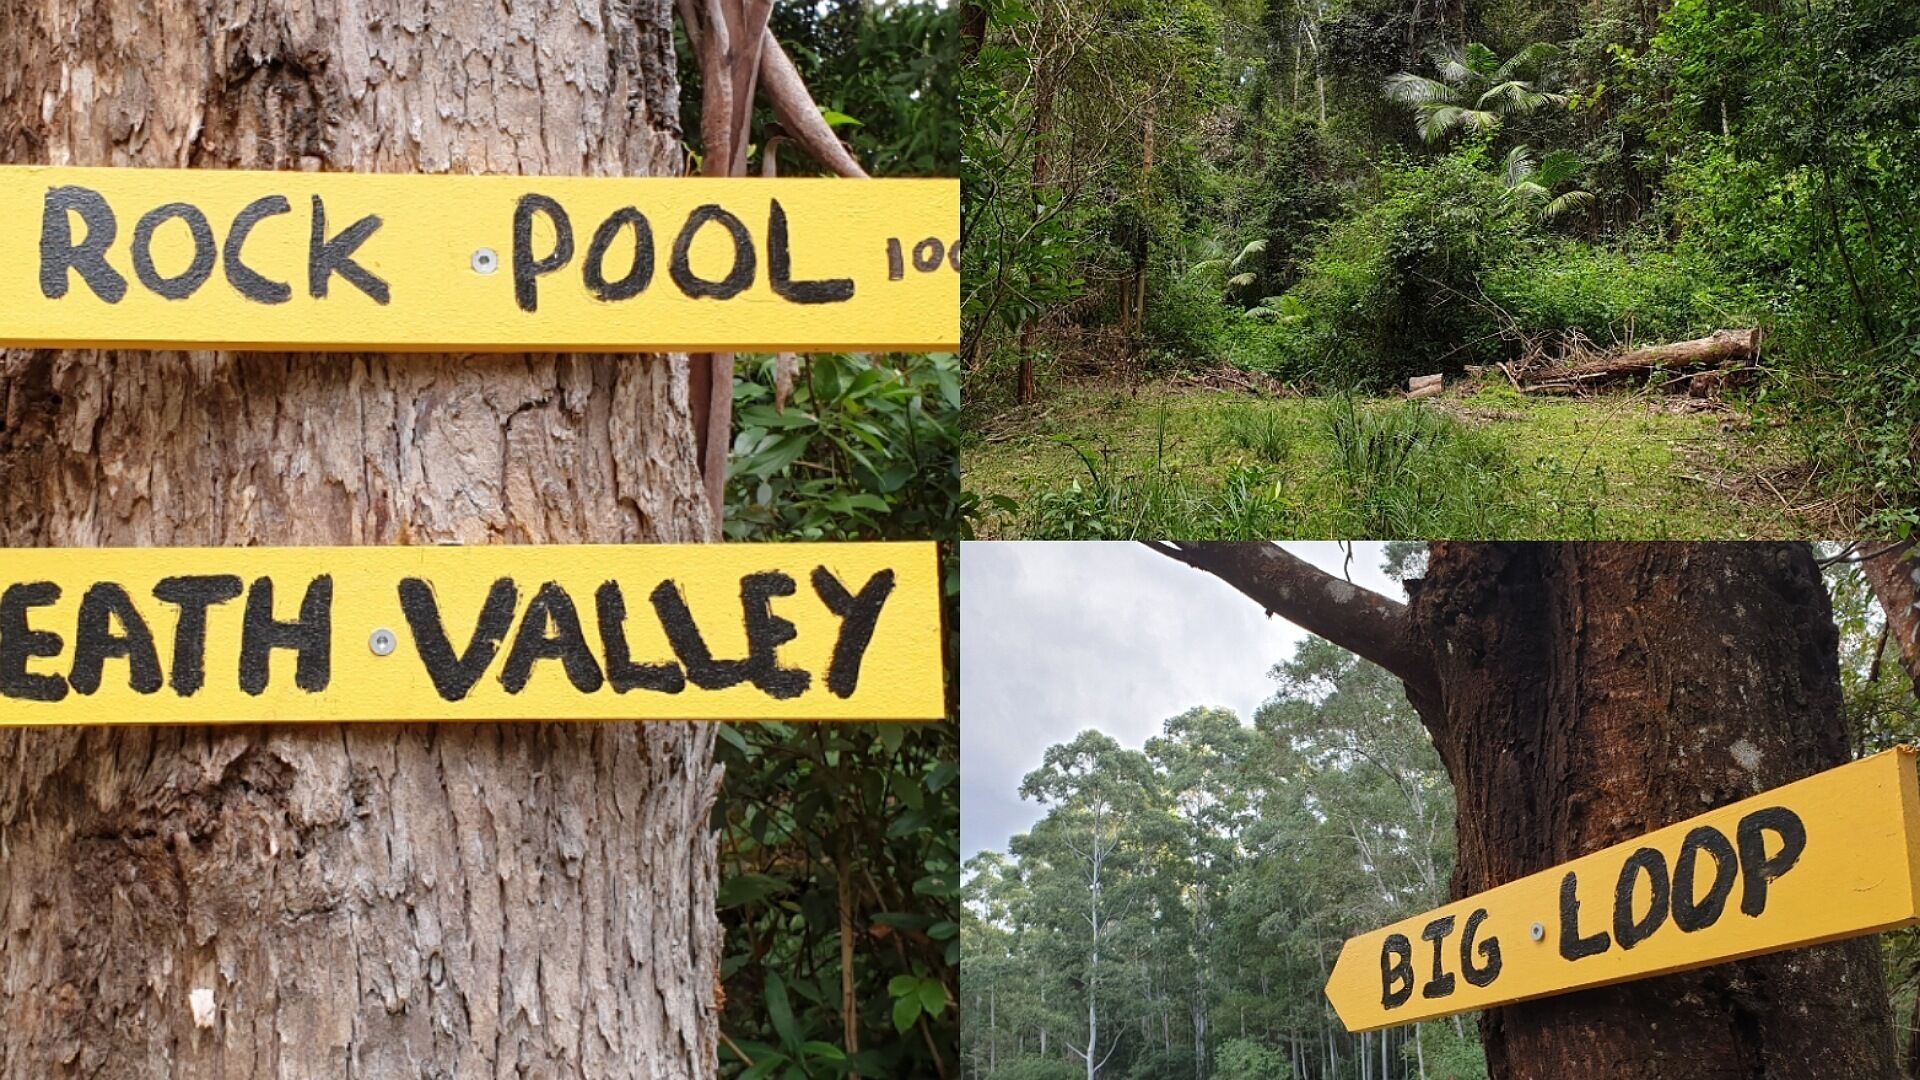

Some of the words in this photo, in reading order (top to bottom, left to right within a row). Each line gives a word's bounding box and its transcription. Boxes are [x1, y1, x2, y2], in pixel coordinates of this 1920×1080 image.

[38, 185, 391, 305] ROCK
[513, 193, 855, 313] POOL
[0, 574, 332, 702] EATH
[397, 565, 896, 702] VALLEY
[1380, 908, 1502, 1011] BIG
[1558, 806, 1807, 962] LOOP
